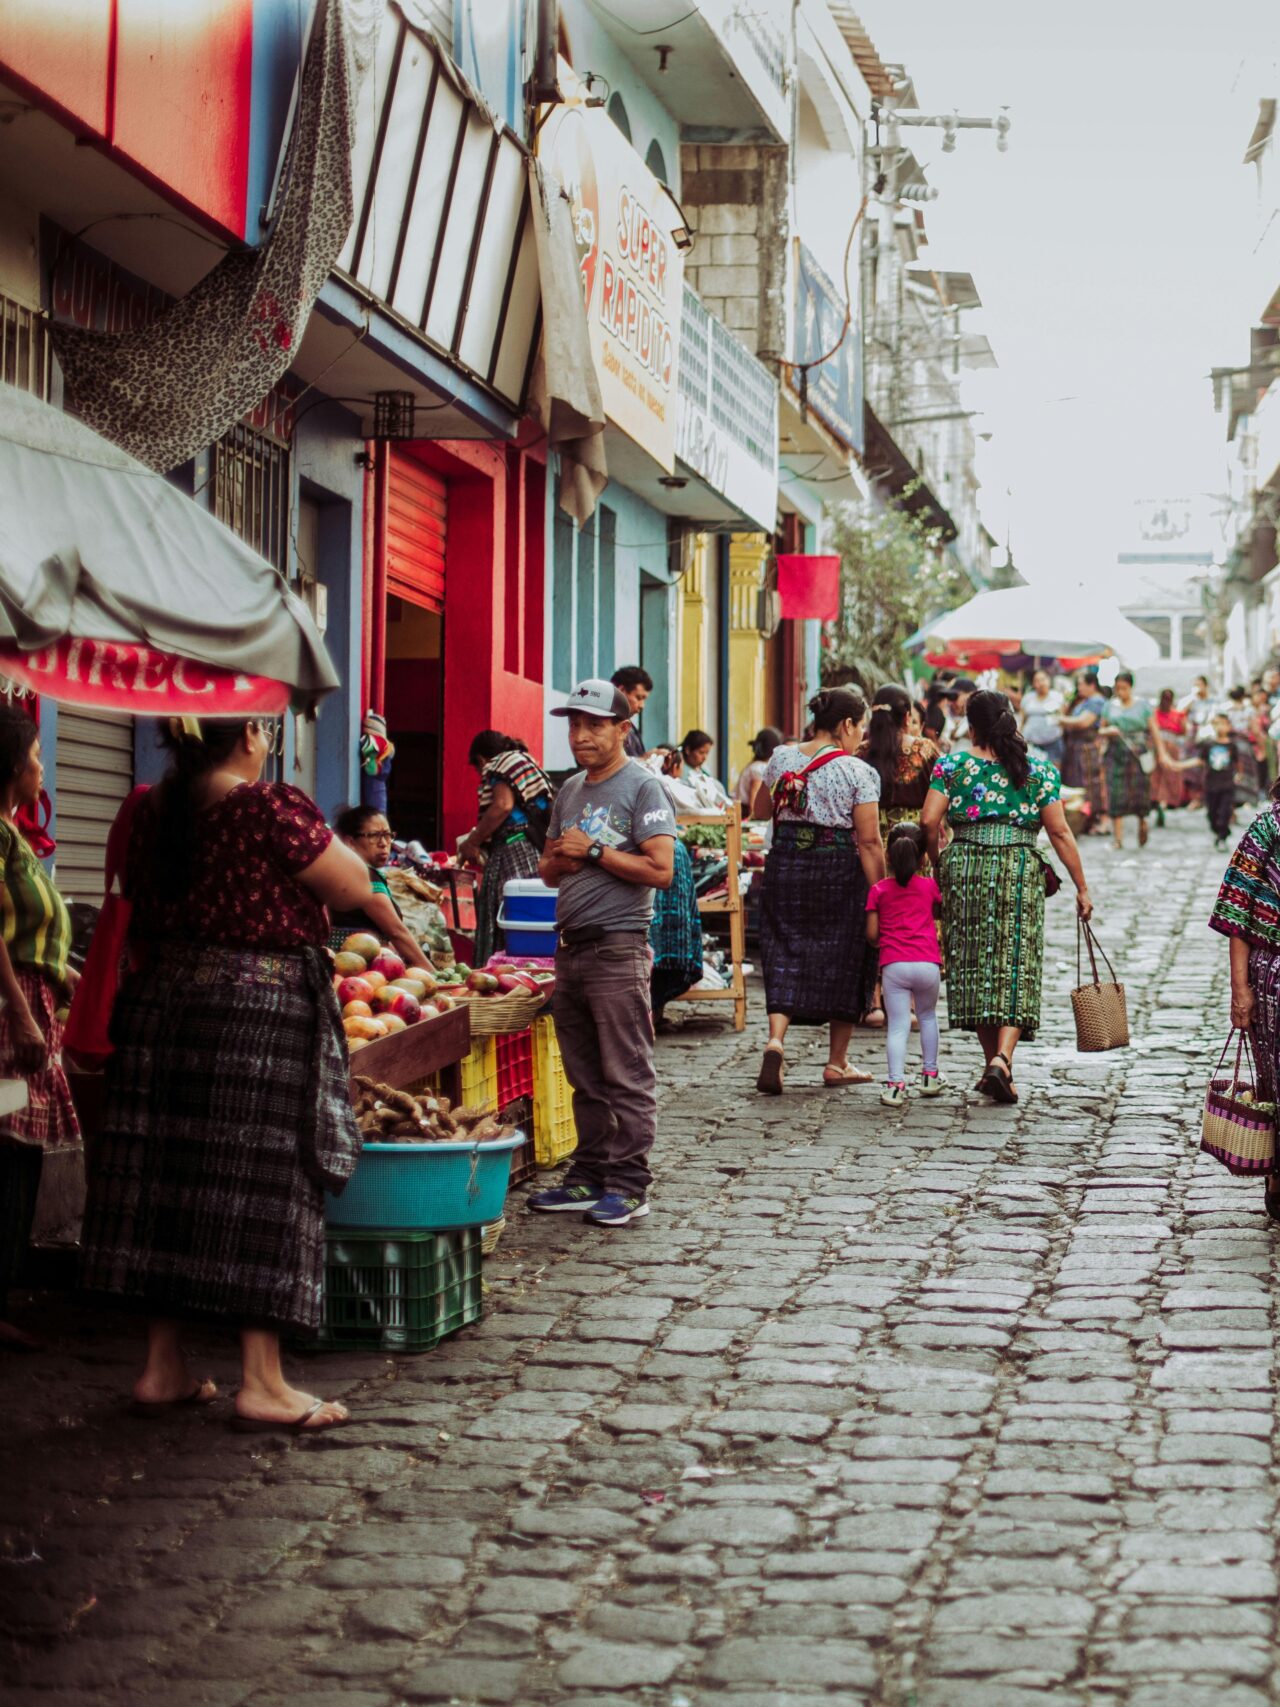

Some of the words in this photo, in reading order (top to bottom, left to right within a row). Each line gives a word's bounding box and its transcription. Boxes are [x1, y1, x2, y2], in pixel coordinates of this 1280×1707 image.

[616, 185, 667, 305] SUPER
[599, 251, 673, 393] RAPIDITO
[643, 808, 669, 826] PKF
